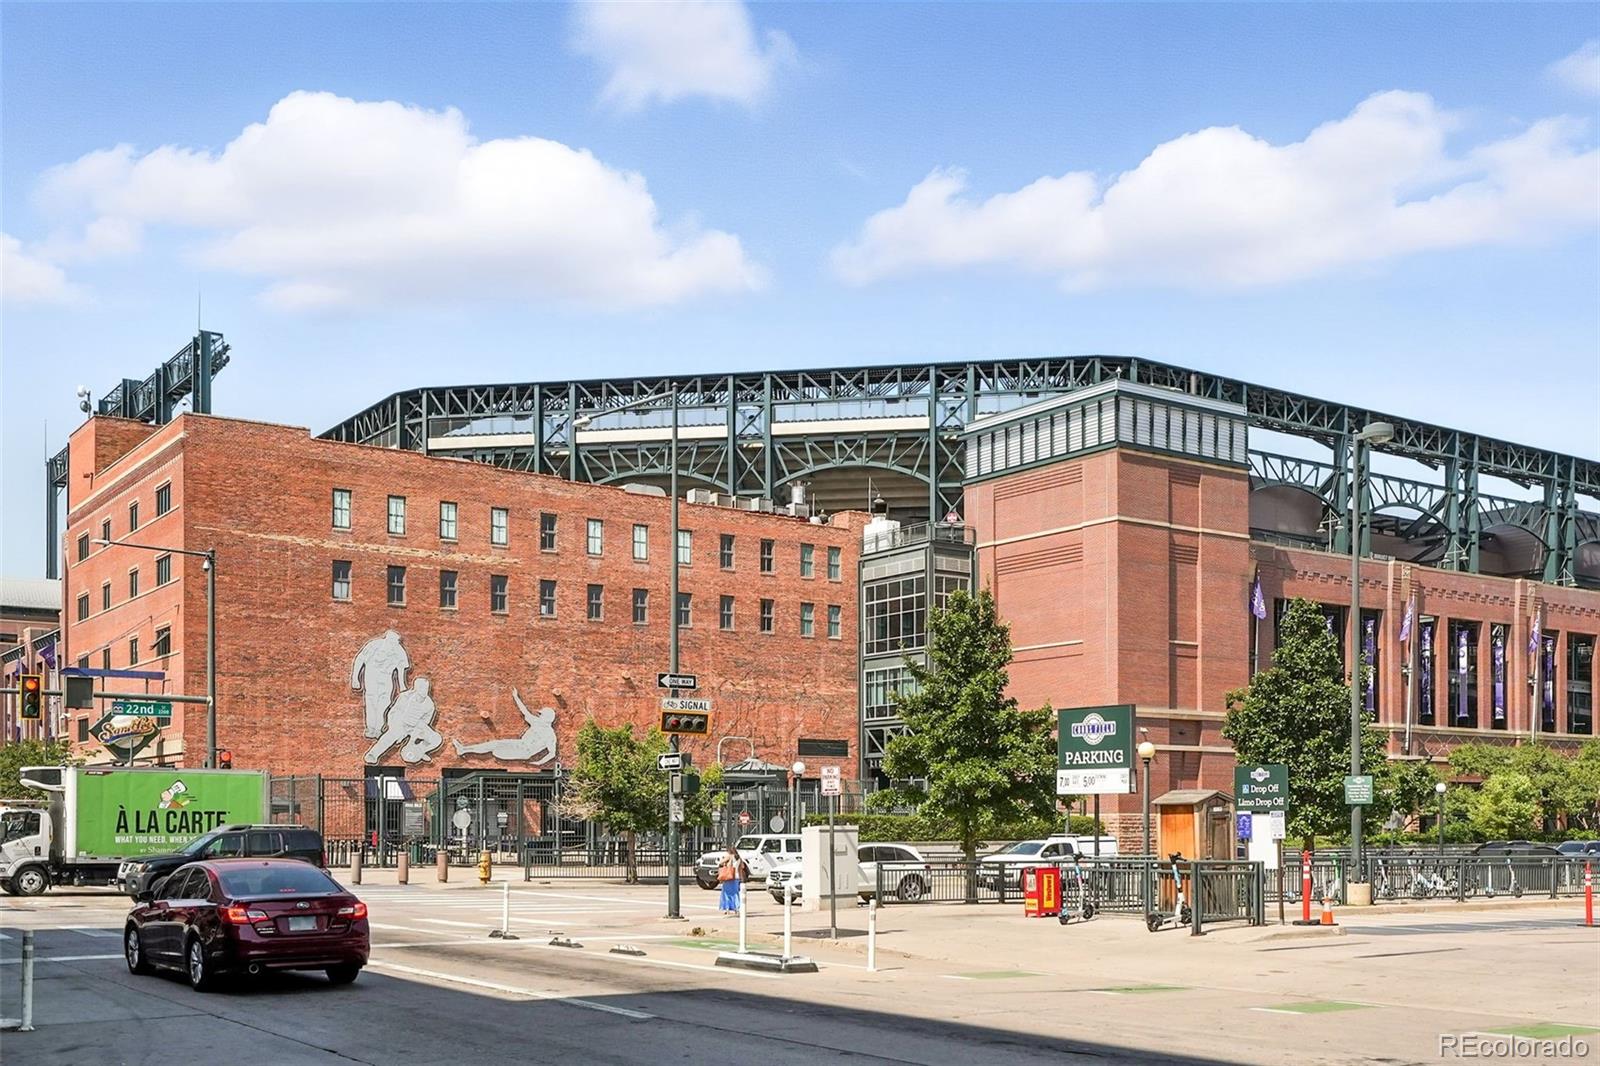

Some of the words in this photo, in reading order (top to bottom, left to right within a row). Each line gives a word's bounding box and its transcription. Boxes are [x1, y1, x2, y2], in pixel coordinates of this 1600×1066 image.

[126, 704, 154, 714] 22nd
[680, 700, 708, 710] SIGNAL
[1065, 750, 1124, 765] PARKING
[1250, 784, 1267, 794] Drop
[1268, 784, 1279, 792] Off
[1238, 798, 1255, 806] Limo
[1255, 798, 1272, 807] Drop
[1273, 797, 1284, 805] Off
[116, 805, 129, 833] À
[135, 811, 160, 833] LA
